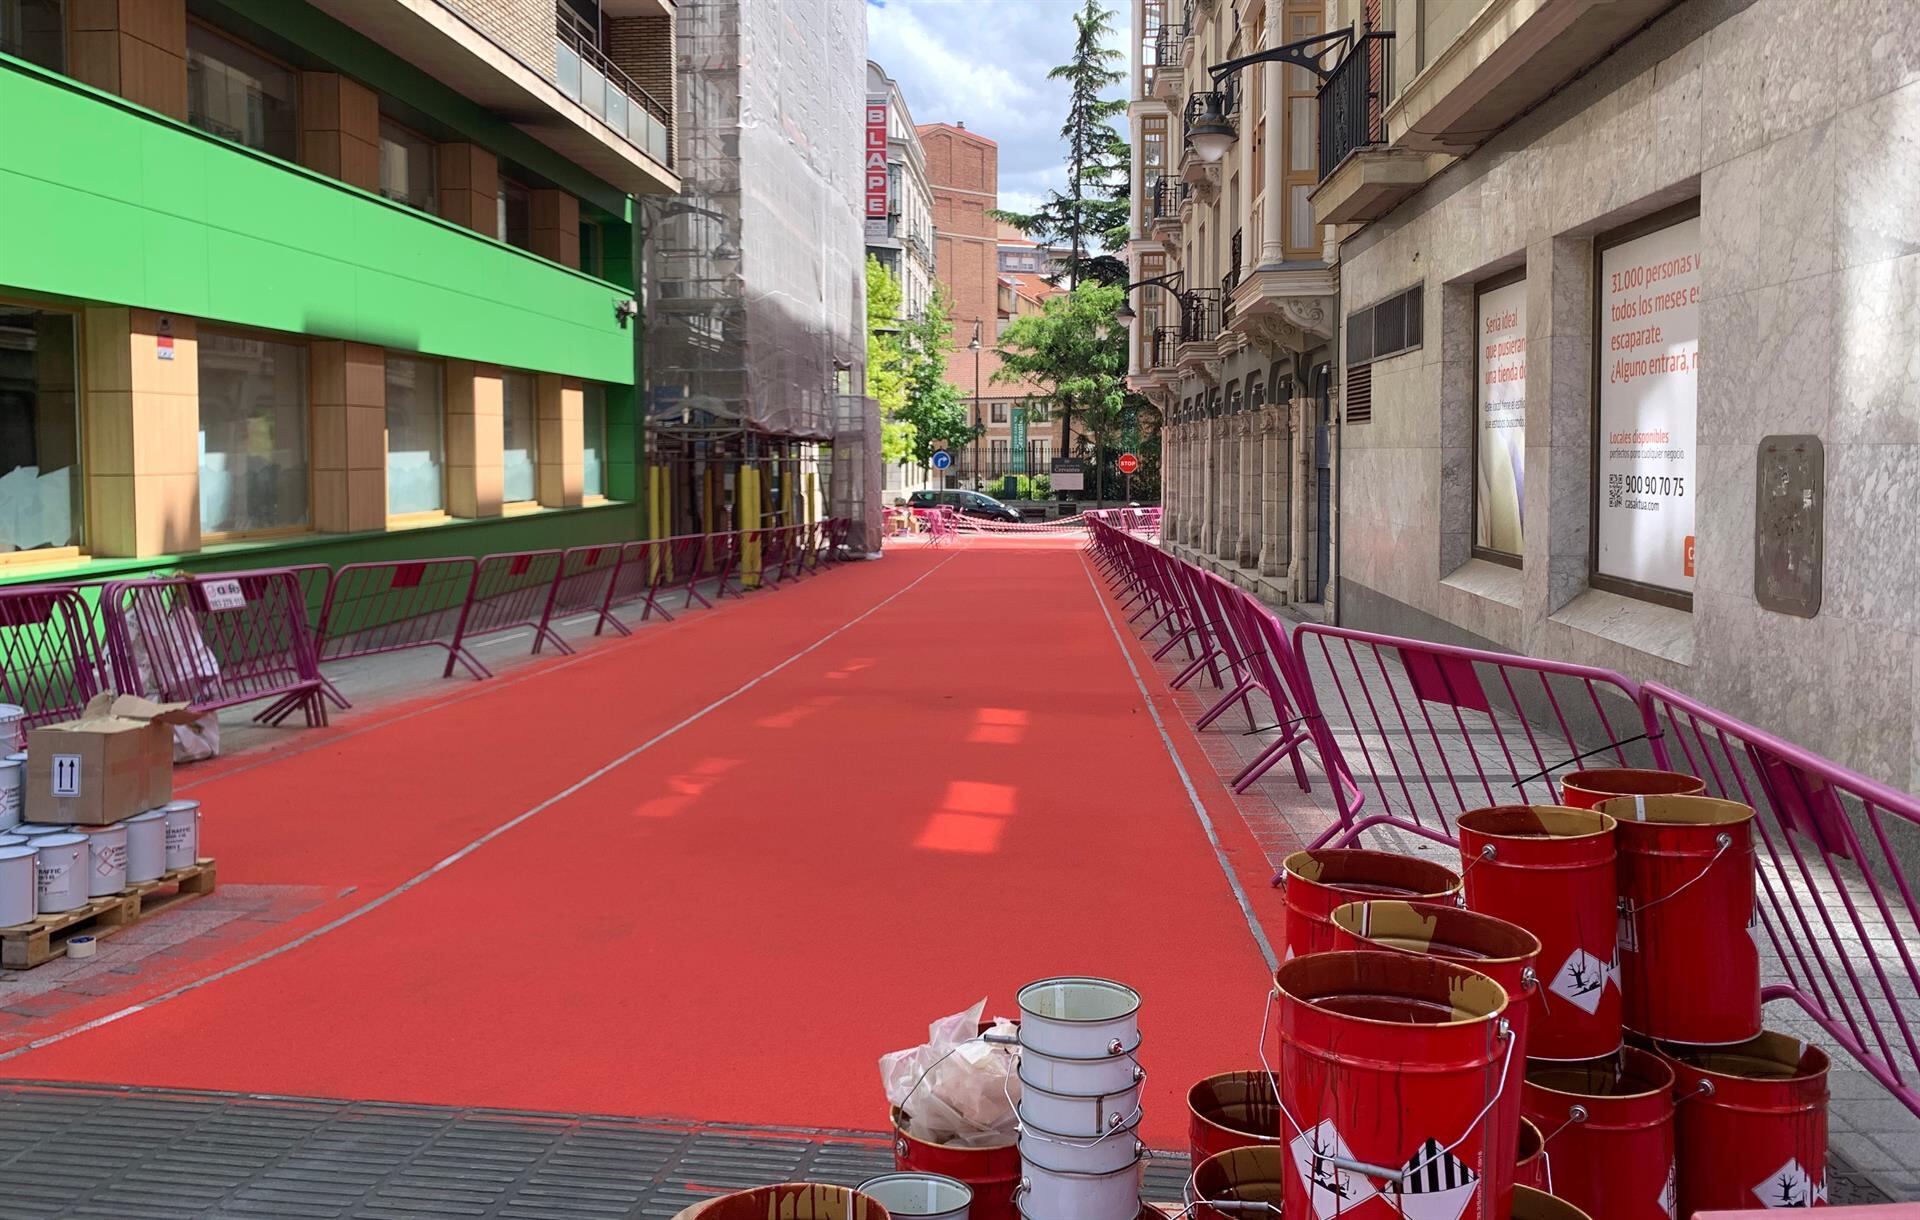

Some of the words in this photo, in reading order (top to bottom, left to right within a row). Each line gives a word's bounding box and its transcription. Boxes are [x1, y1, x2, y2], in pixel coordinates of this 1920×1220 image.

[867, 109, 886, 212] BLAPE
[1612, 266, 1643, 293] 31.000
[1646, 255, 1692, 289] personas
[1611, 298, 1636, 322] todos
[1639, 294, 1652, 316] los
[1655, 288, 1687, 312] meses
[1502, 307, 1518, 330] ideal
[1486, 343, 1497, 364] que
[1498, 335, 1526, 362] pusieran
[1611, 324, 1663, 352] escaparate.
[1485, 370, 1497, 384] una
[1498, 361, 1518, 383] tienda
[1610, 358, 1647, 384] ¿Alguno
[1649, 348, 1689, 375] entrará,
[1609, 431, 1631, 445] Locales
[1632, 428, 1669, 447] disponibles
[1609, 448, 1630, 460] perfectos
[1630, 450, 1641, 460] para
[1664, 448, 1684, 462] negocio
[1625, 475, 1642, 494] 900
[1645, 476, 1657, 495] 90
[1659, 476, 1670, 496] 70
[1673, 477, 1684, 497] 75
[1624, 499, 1660, 512] casaktua.com
